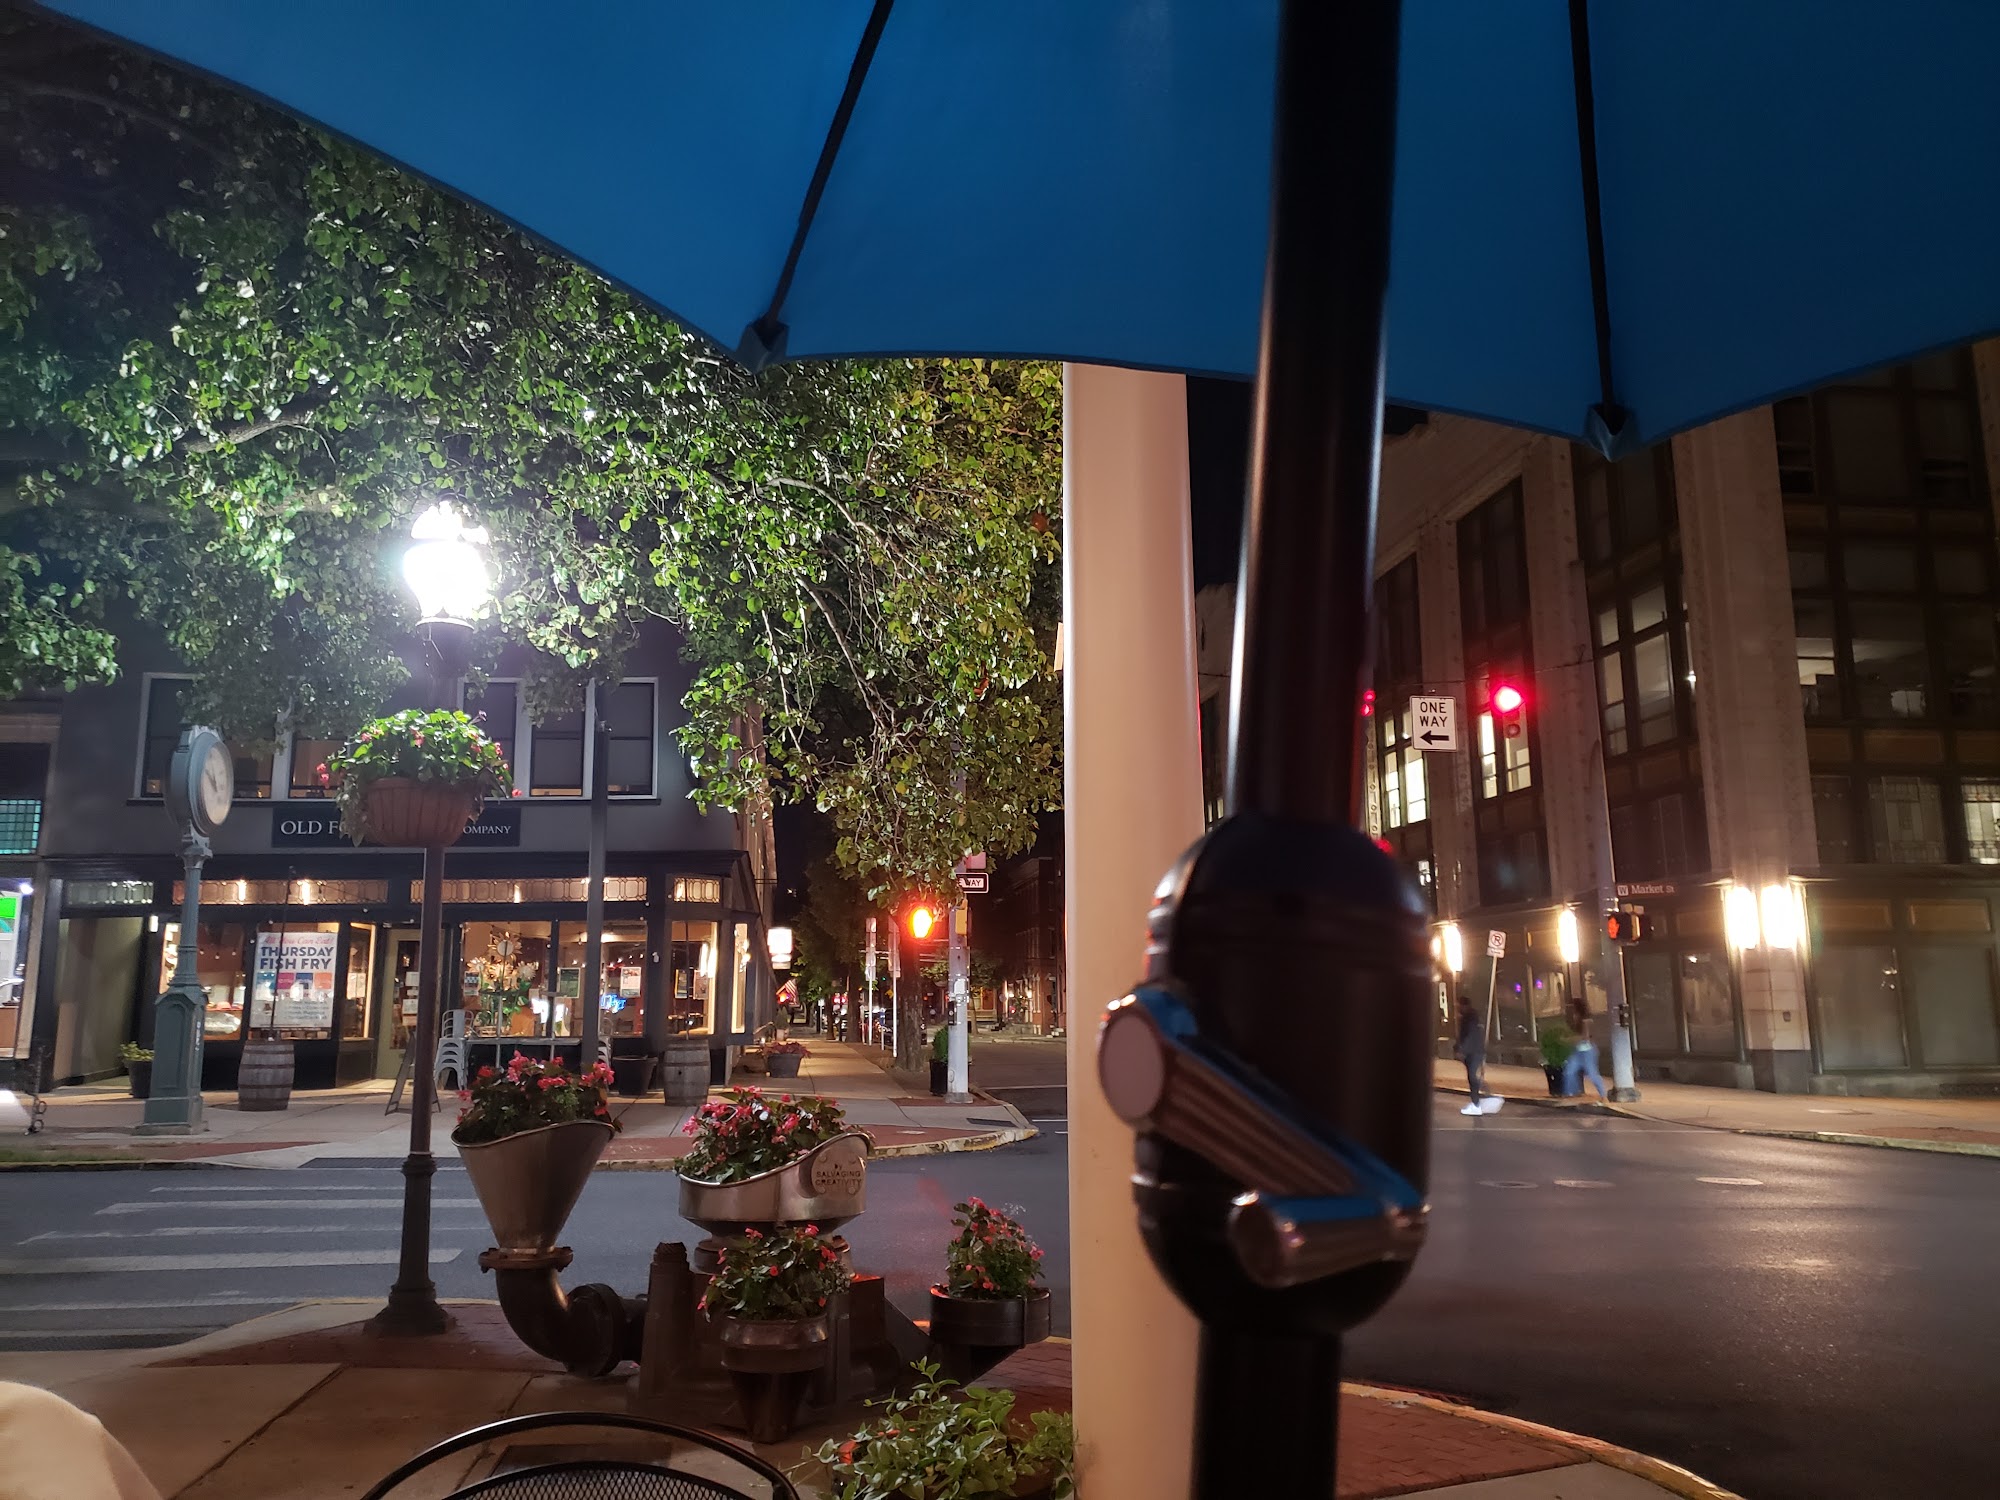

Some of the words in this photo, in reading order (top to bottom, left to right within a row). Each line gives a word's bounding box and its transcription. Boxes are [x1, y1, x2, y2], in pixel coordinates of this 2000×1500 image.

[1420, 701, 1447, 713] ONE
[1419, 715, 1448, 727] WAY
[280, 820, 322, 834] OLD
[462, 825, 512, 834] OMPANY
[1631, 884, 1664, 894] Market
[260, 946, 335, 957] THURSDAY
[260, 958, 297, 969] FISH
[301, 958, 332, 969] FRY
[815, 1178, 862, 1186] CREATIVITY
